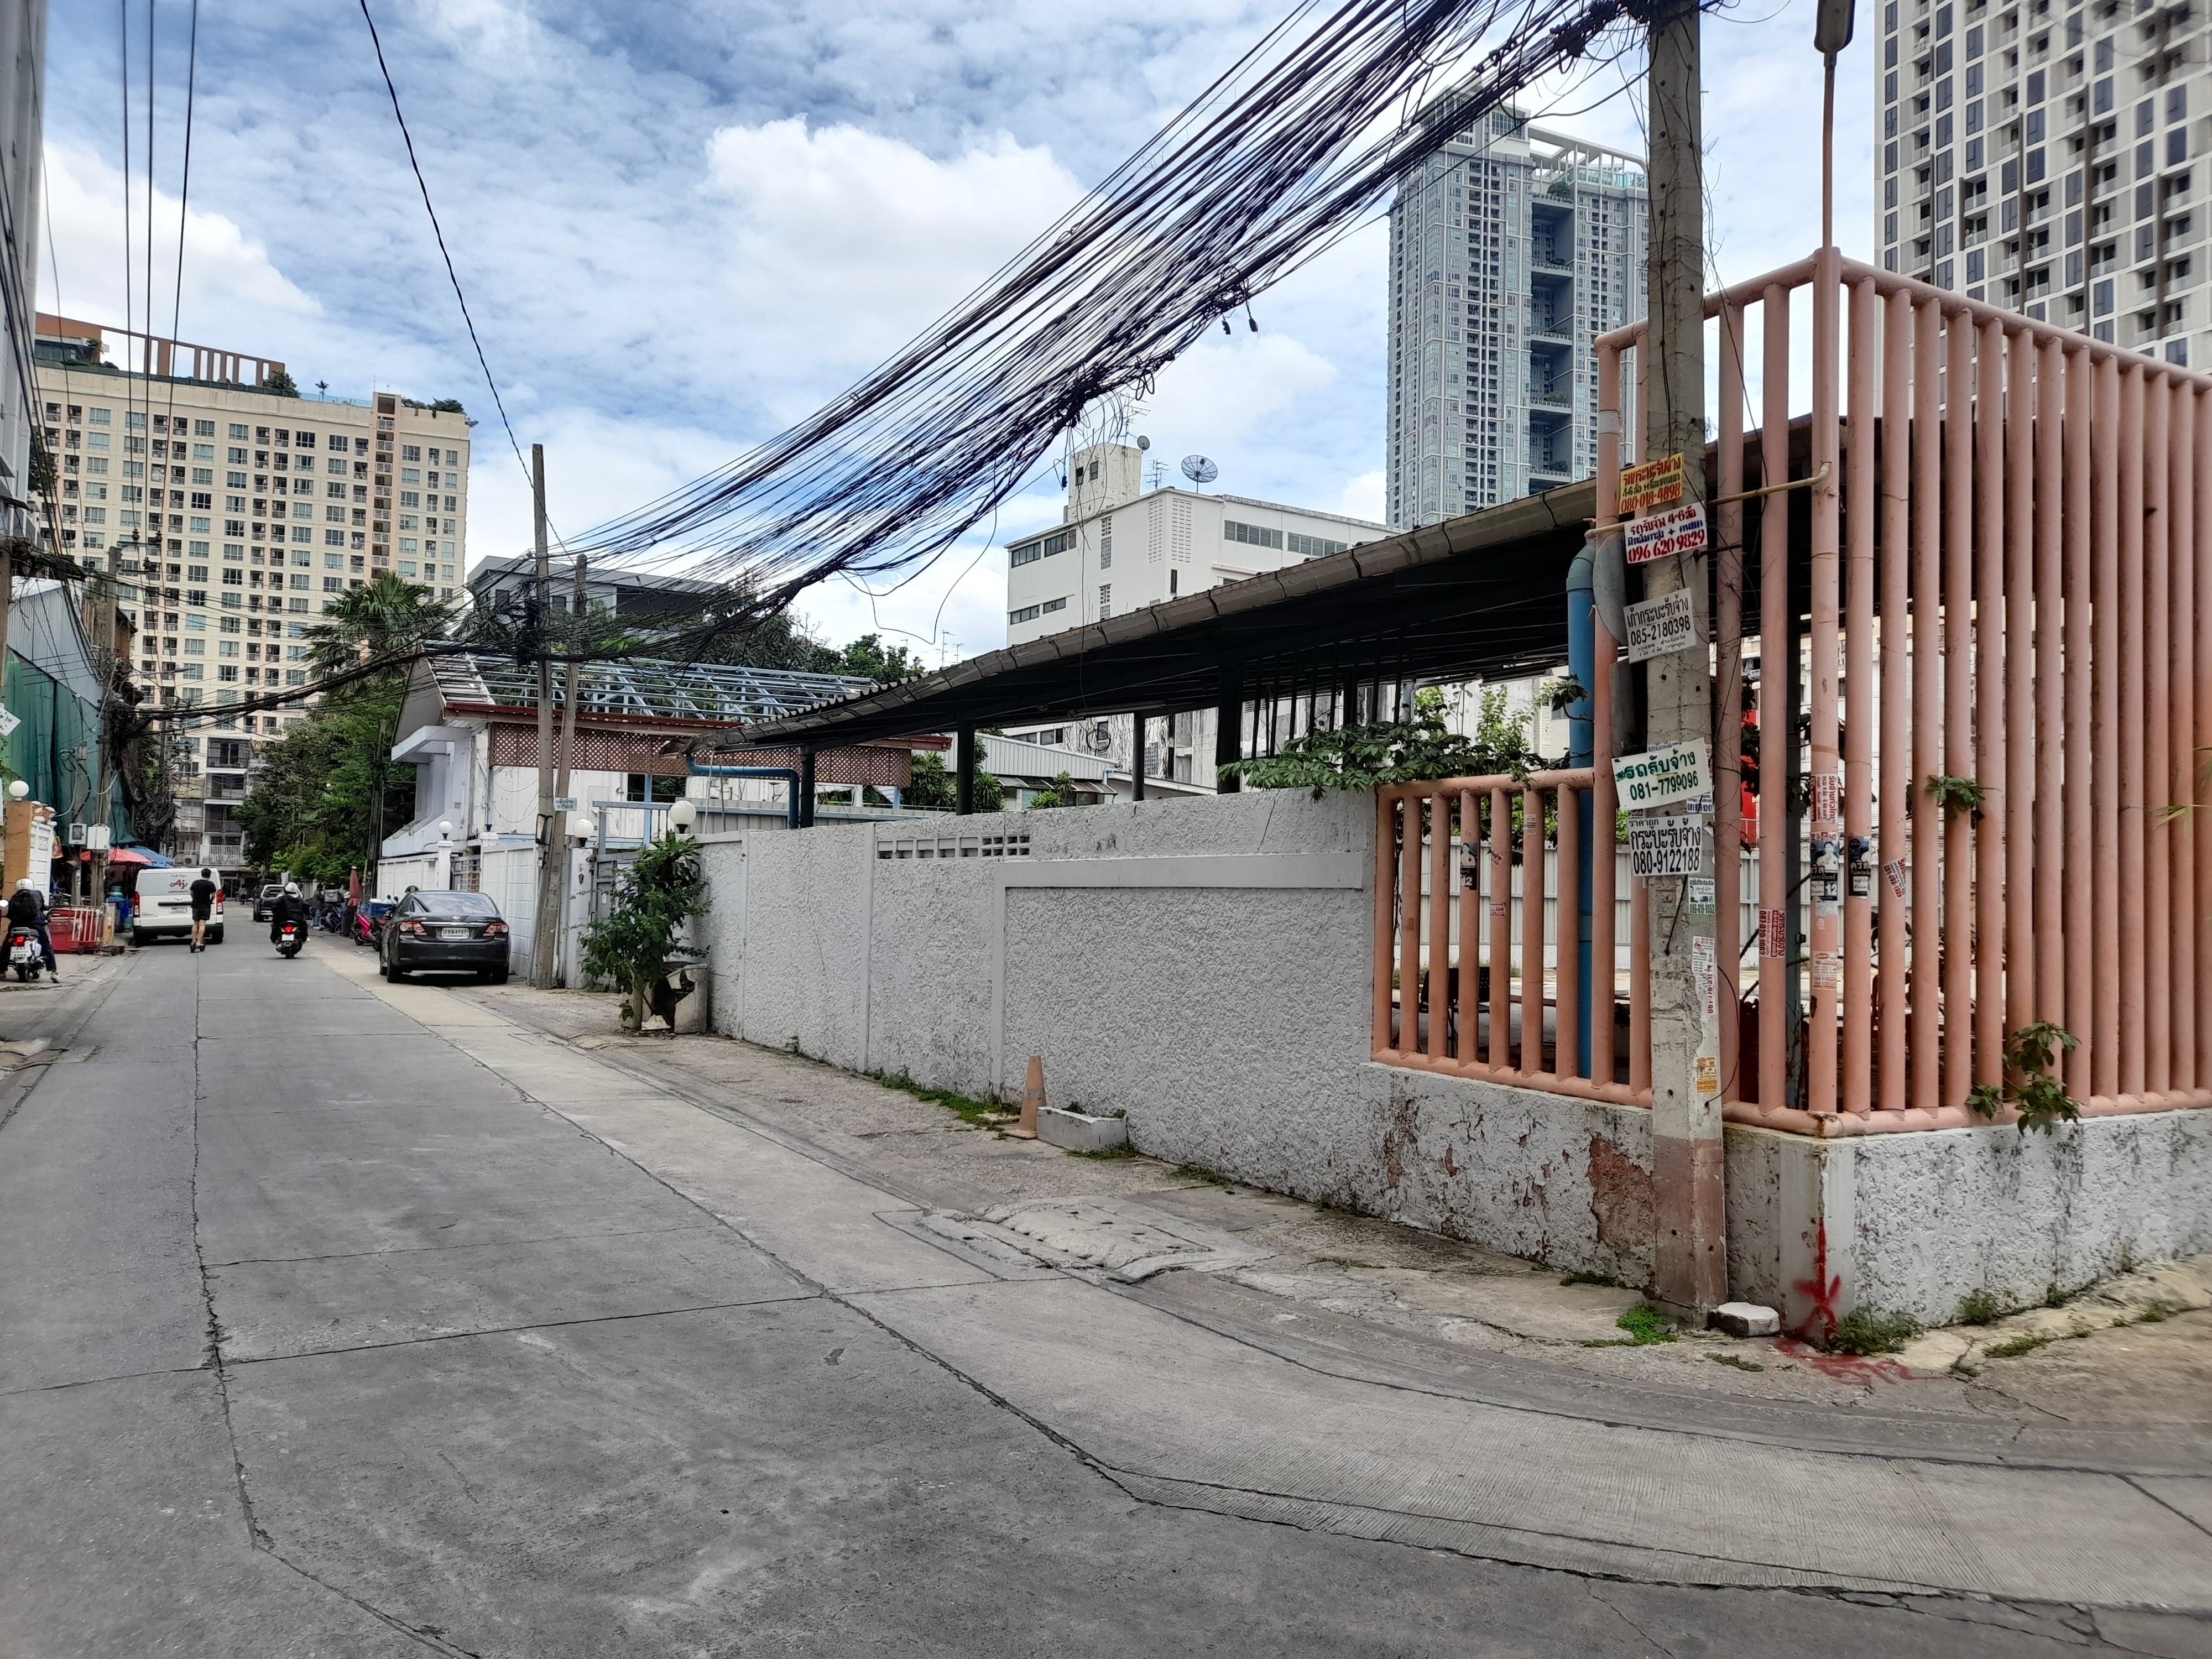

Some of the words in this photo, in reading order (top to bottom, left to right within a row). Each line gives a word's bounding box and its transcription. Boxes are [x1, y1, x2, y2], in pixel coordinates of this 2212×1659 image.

[1621, 482, 1681, 513] 080-018-4898
[1629, 544, 1651, 562] 096
[1653, 538, 1674, 556] 620
[1677, 529, 1705, 550] 9829
[1631, 615, 1691, 646] 085-2180398
[1630, 770, 1698, 801] 081-7799096
[1629, 819, 1659, 829] ราคาถูก
[1631, 818, 1701, 850] กระบะรับจ้าง
[1633, 847, 1700, 874] 080-9122188
[1825, 884, 1837, 895] 12
